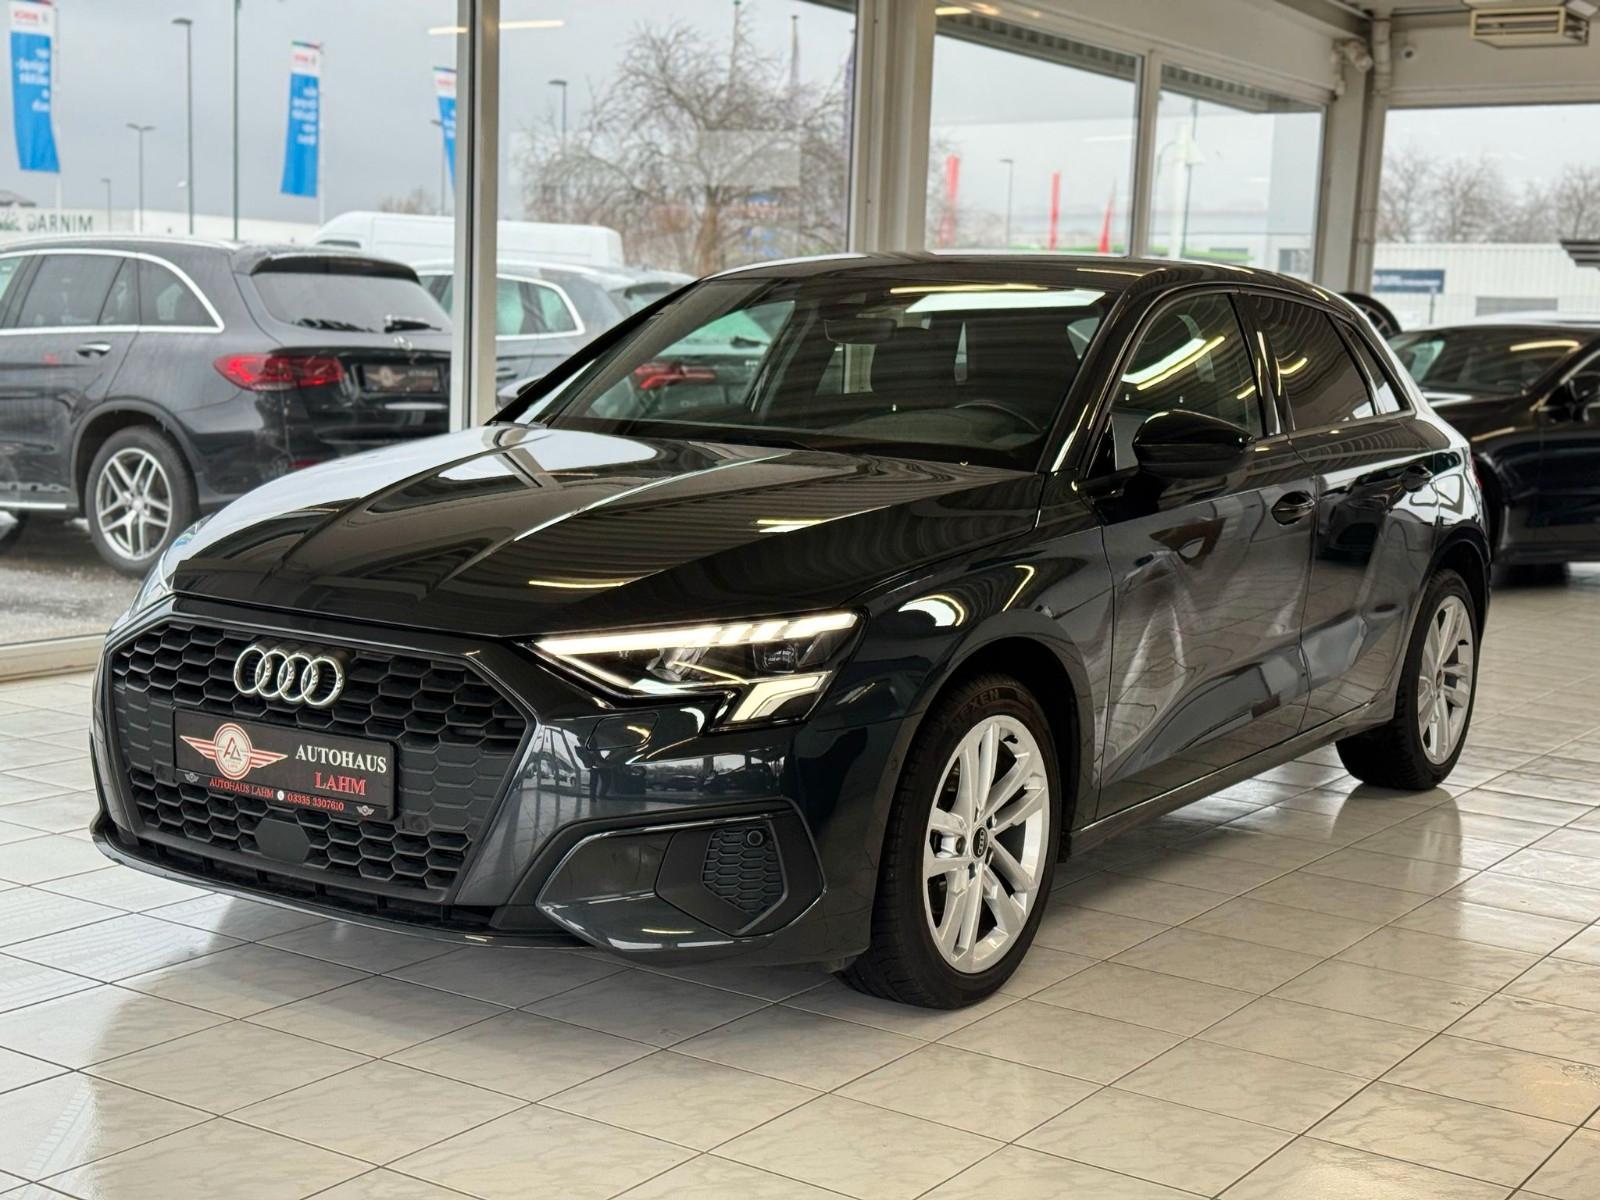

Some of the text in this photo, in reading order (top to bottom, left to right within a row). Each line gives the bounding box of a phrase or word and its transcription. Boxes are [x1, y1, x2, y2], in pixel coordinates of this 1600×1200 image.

[295, 744, 387, 773] AUTOHAUS
[209, 778, 250, 794] AUTOHAUS
[251, 785, 274, 799] LAHM
[287, 793, 311, 806] 03335
[314, 772, 366, 796] LAHM
